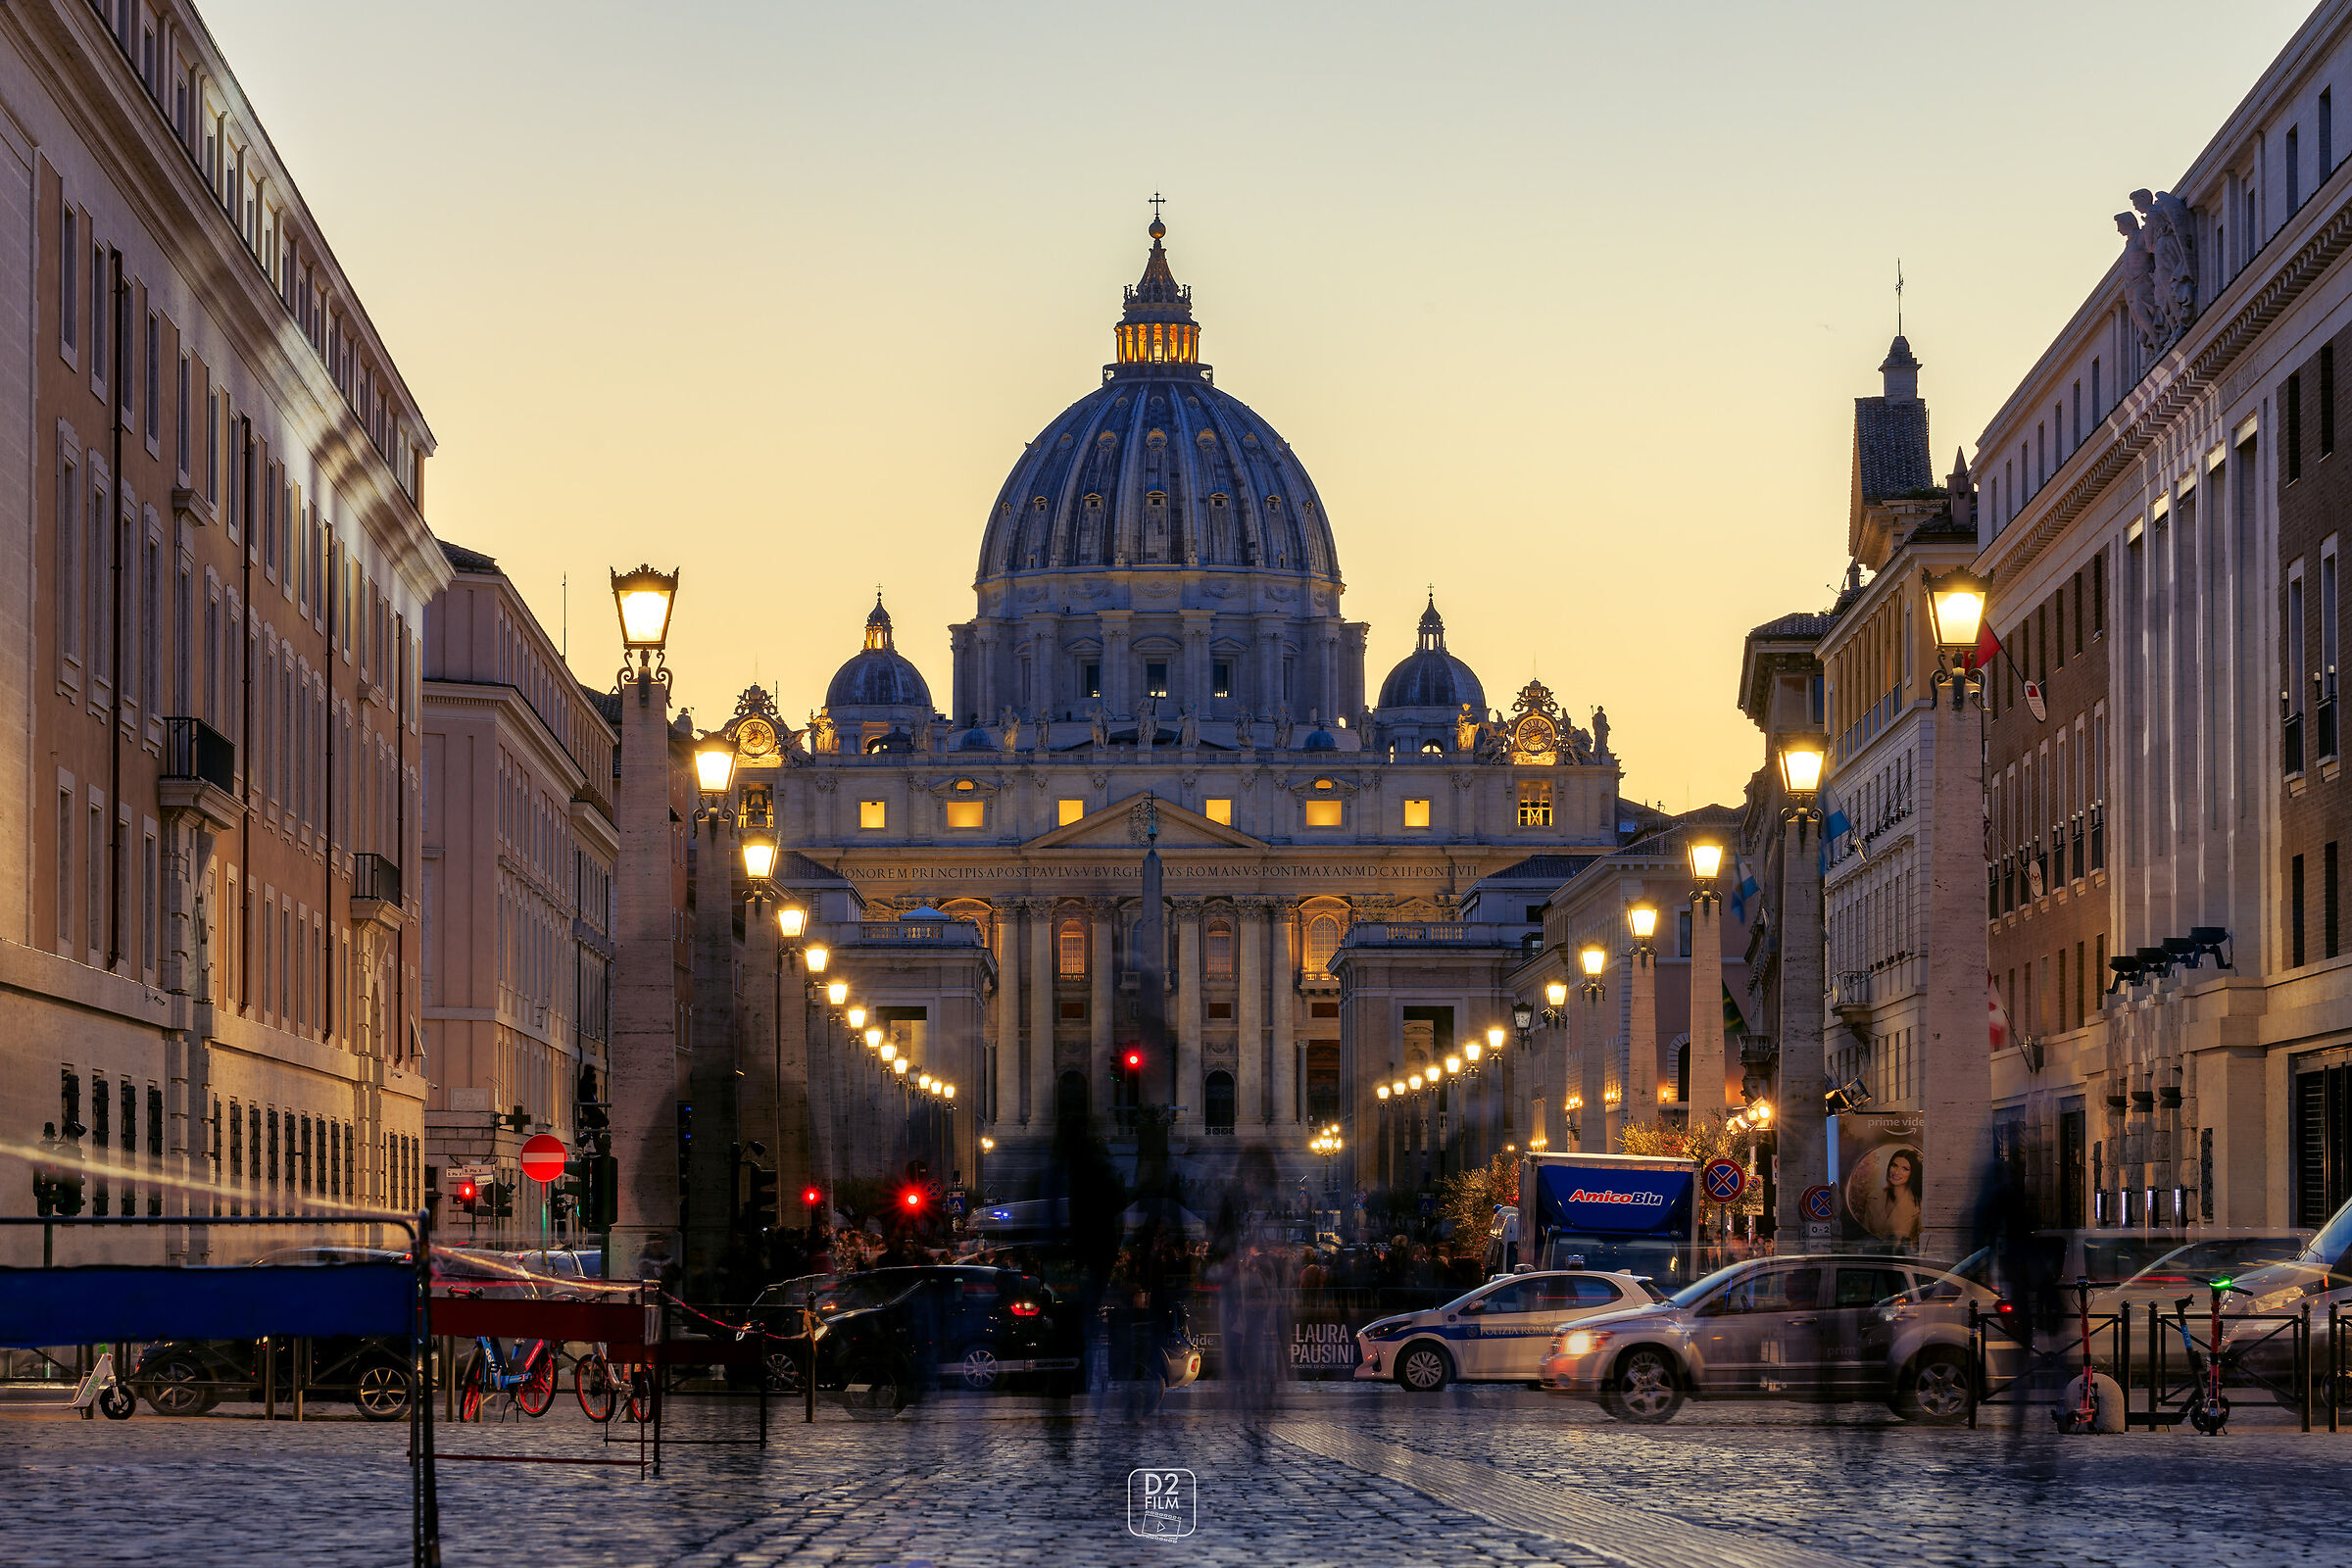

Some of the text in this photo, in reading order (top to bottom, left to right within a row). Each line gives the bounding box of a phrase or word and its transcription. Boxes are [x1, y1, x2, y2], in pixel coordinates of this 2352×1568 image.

[912, 867, 985, 878] PRINCIPIS
[1033, 866, 1080, 878] PAVLVS
[1186, 866, 1258, 877] ROMANVS
[1354, 866, 1411, 877] MDCXII
[1415, 866, 1453, 877] PONT
[1457, 866, 1477, 877] VII
[1868, 1117, 1925, 1128] prime vide
[1569, 1189, 1663, 1205] AmicoBlu
[1296, 1323, 1349, 1344] LAURA
[1480, 1326, 1519, 1335] POLIZIA
[1521, 1325, 1551, 1334] ROMA
[1291, 1344, 1354, 1363] PAUSINI
